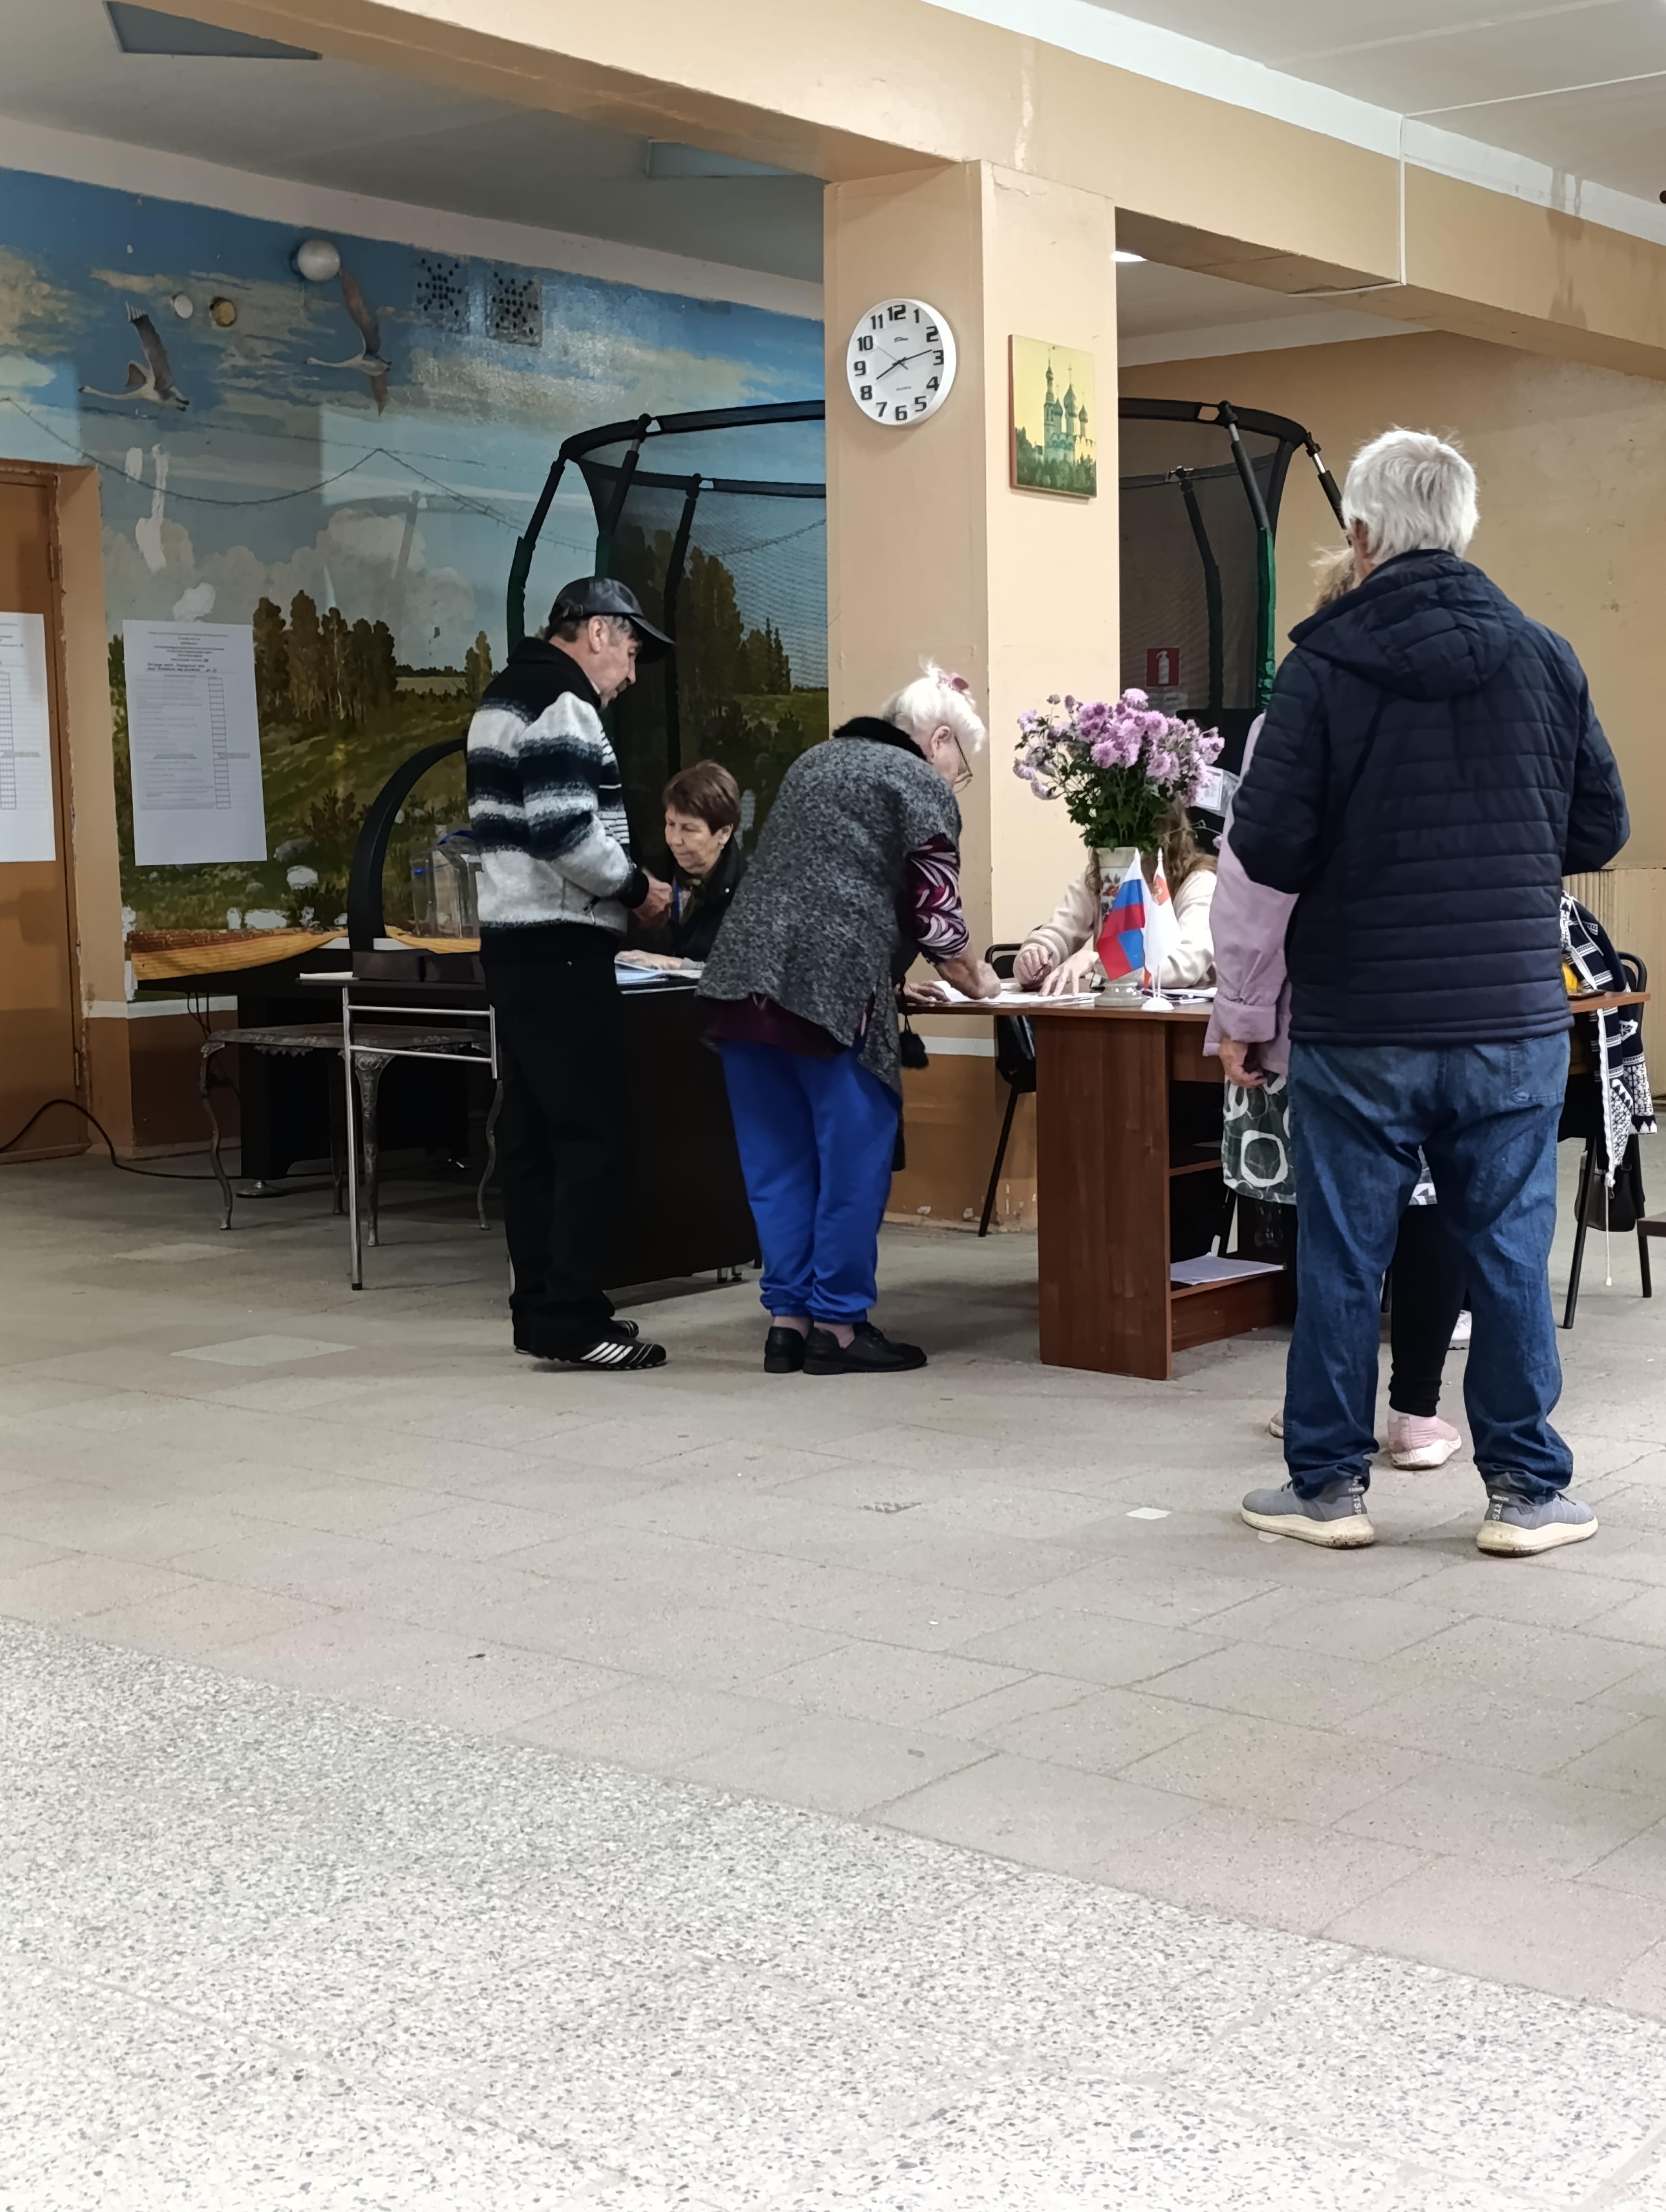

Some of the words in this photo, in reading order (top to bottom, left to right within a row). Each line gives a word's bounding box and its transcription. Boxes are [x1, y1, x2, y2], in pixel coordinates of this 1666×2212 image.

[887, 304, 906, 321] 12
[914, 308, 920, 324] 1
[870, 313, 883, 330] 11
[926, 326, 939, 343] 2
[857, 335, 874, 351] 10
[933, 350, 944, 366] 3
[854, 361, 867, 377] 9
[926, 376, 939, 391] 4
[860, 385, 873, 401] 8
[875, 402, 887, 417] 7
[914, 396, 927, 412] 5
[895, 406, 907, 421] 6
